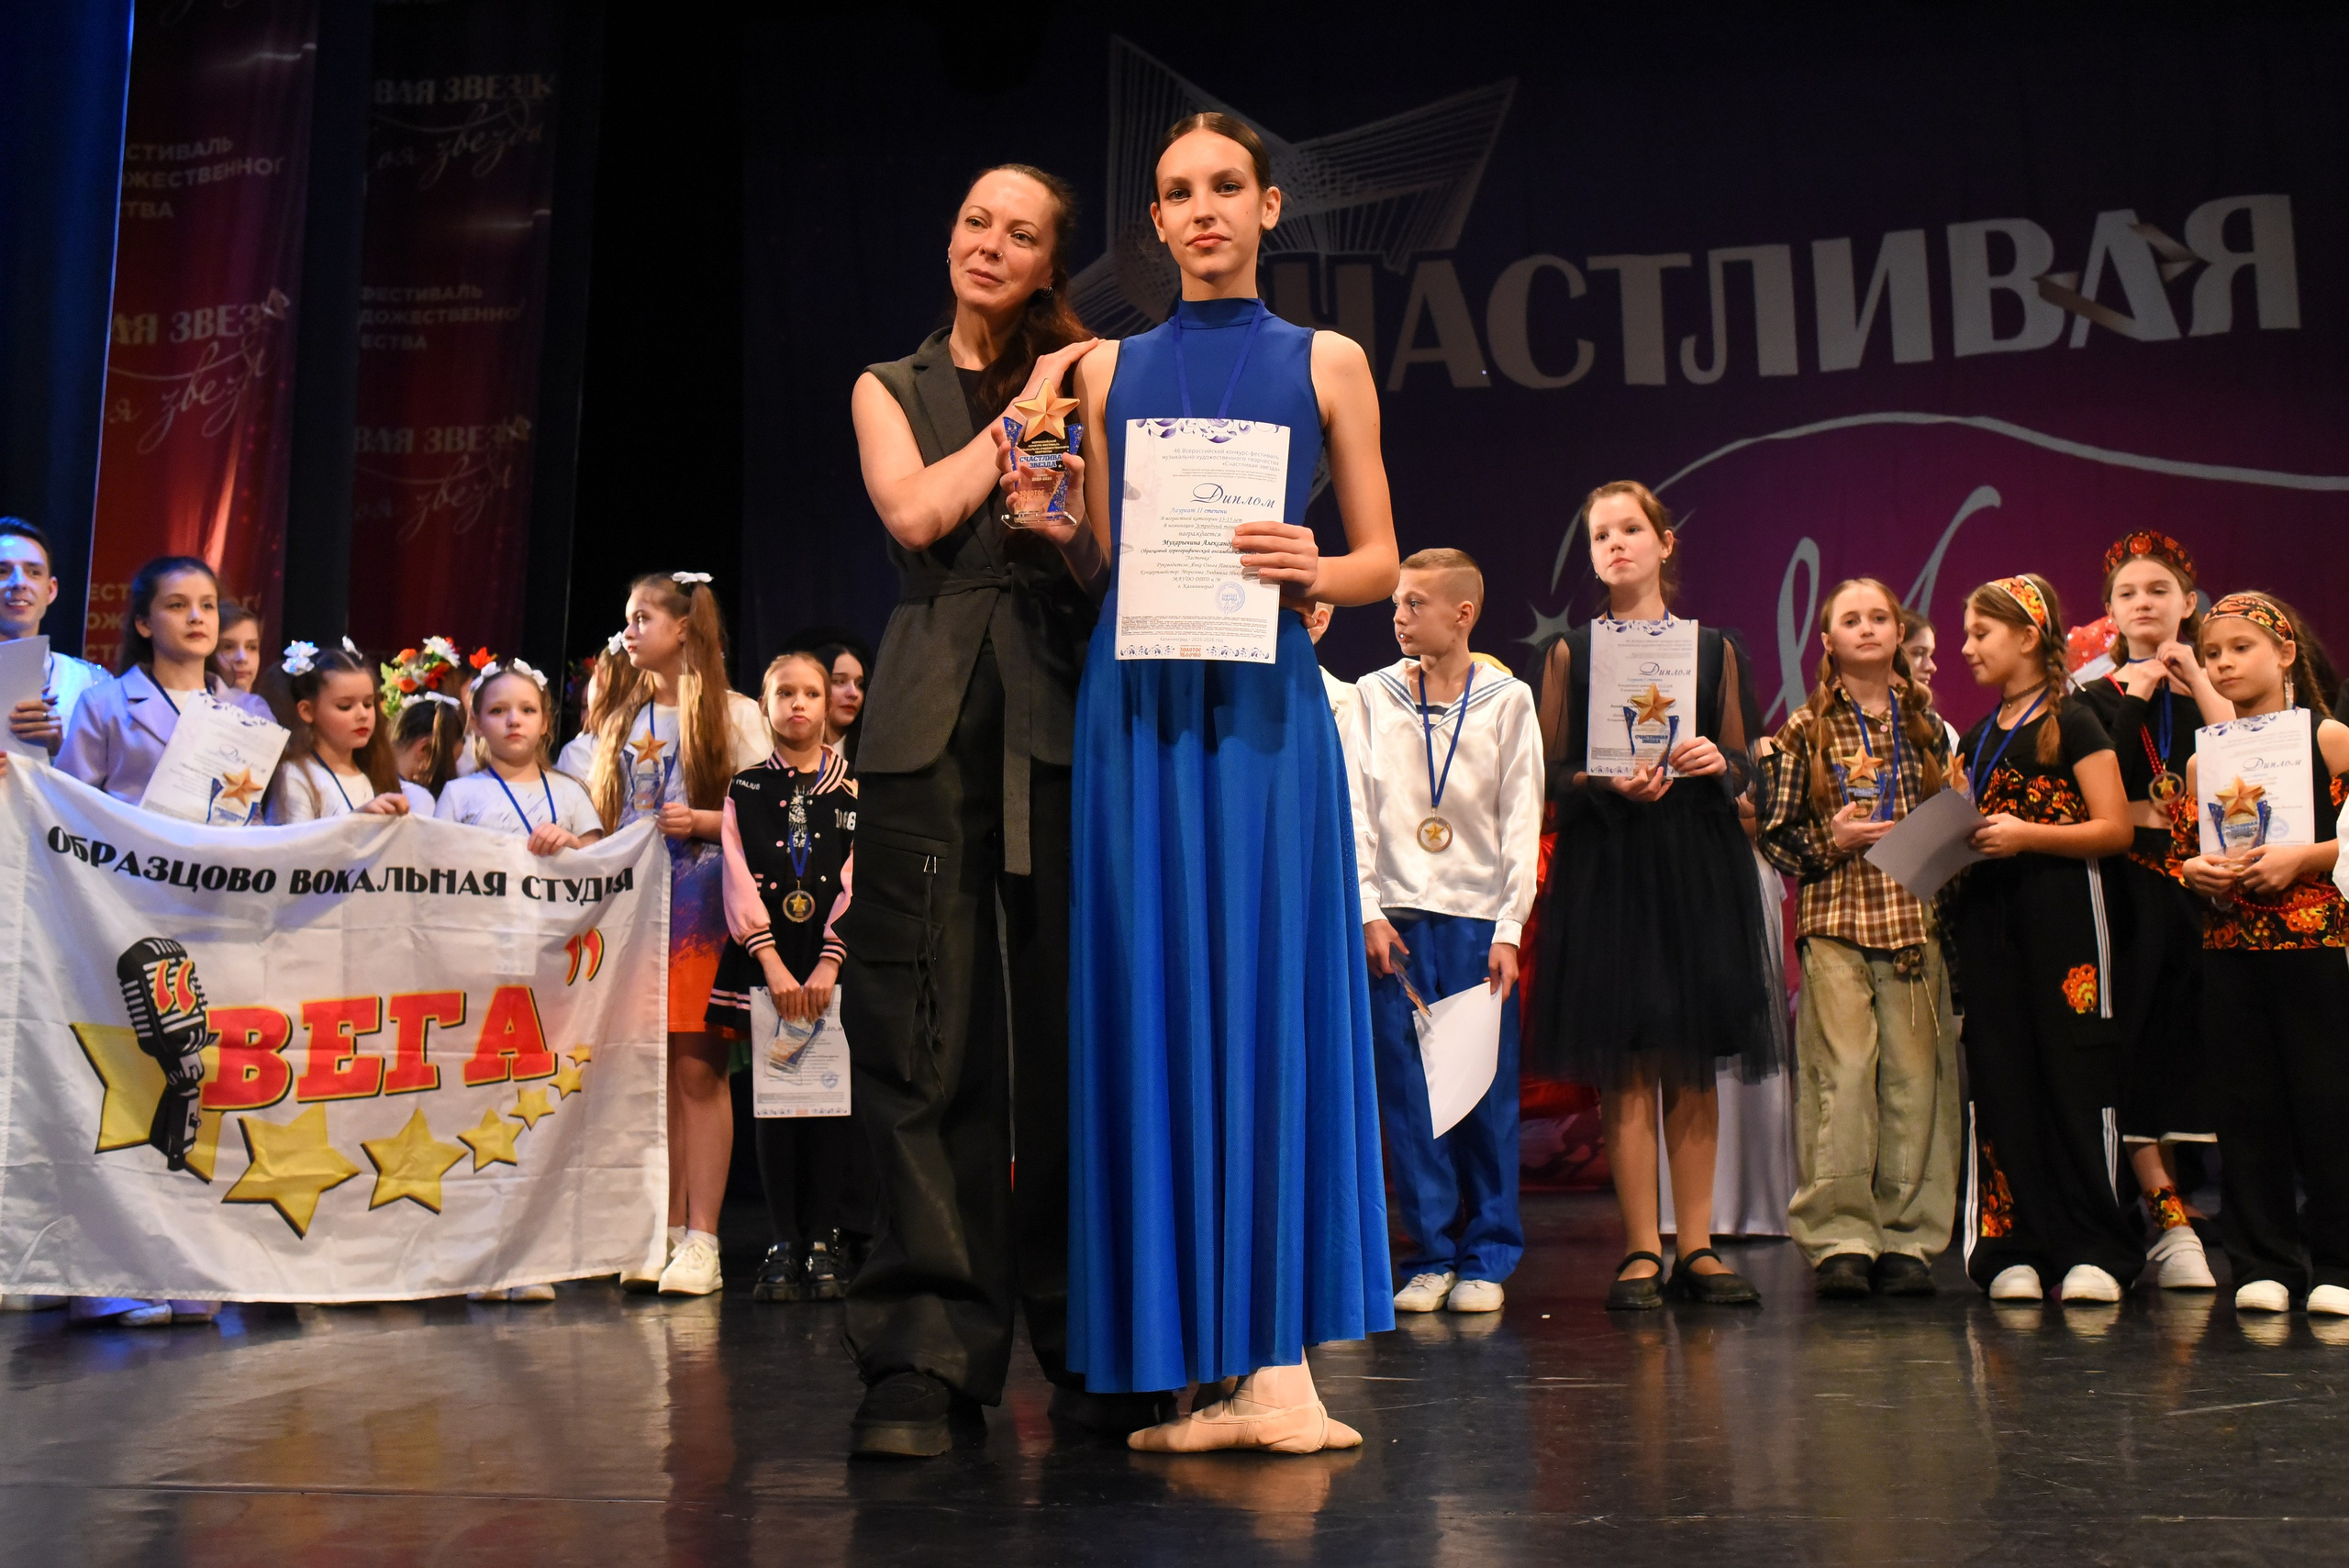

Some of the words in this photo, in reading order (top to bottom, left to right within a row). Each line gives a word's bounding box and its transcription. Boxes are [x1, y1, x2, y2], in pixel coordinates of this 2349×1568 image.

[1264, 194, 2301, 393] ЧАСТЛИВАЯ
[1019, 454, 1063, 462] СЧАСТЛИВА
[1190, 483, 1275, 508] Диплом
[1202, 539, 1233, 549] Александр
[1639, 662, 1692, 677] Диплом
[48, 826, 276, 893] ОБРАЗЦОВО
[289, 867, 507, 896] ВОКАЛЬНАЯ
